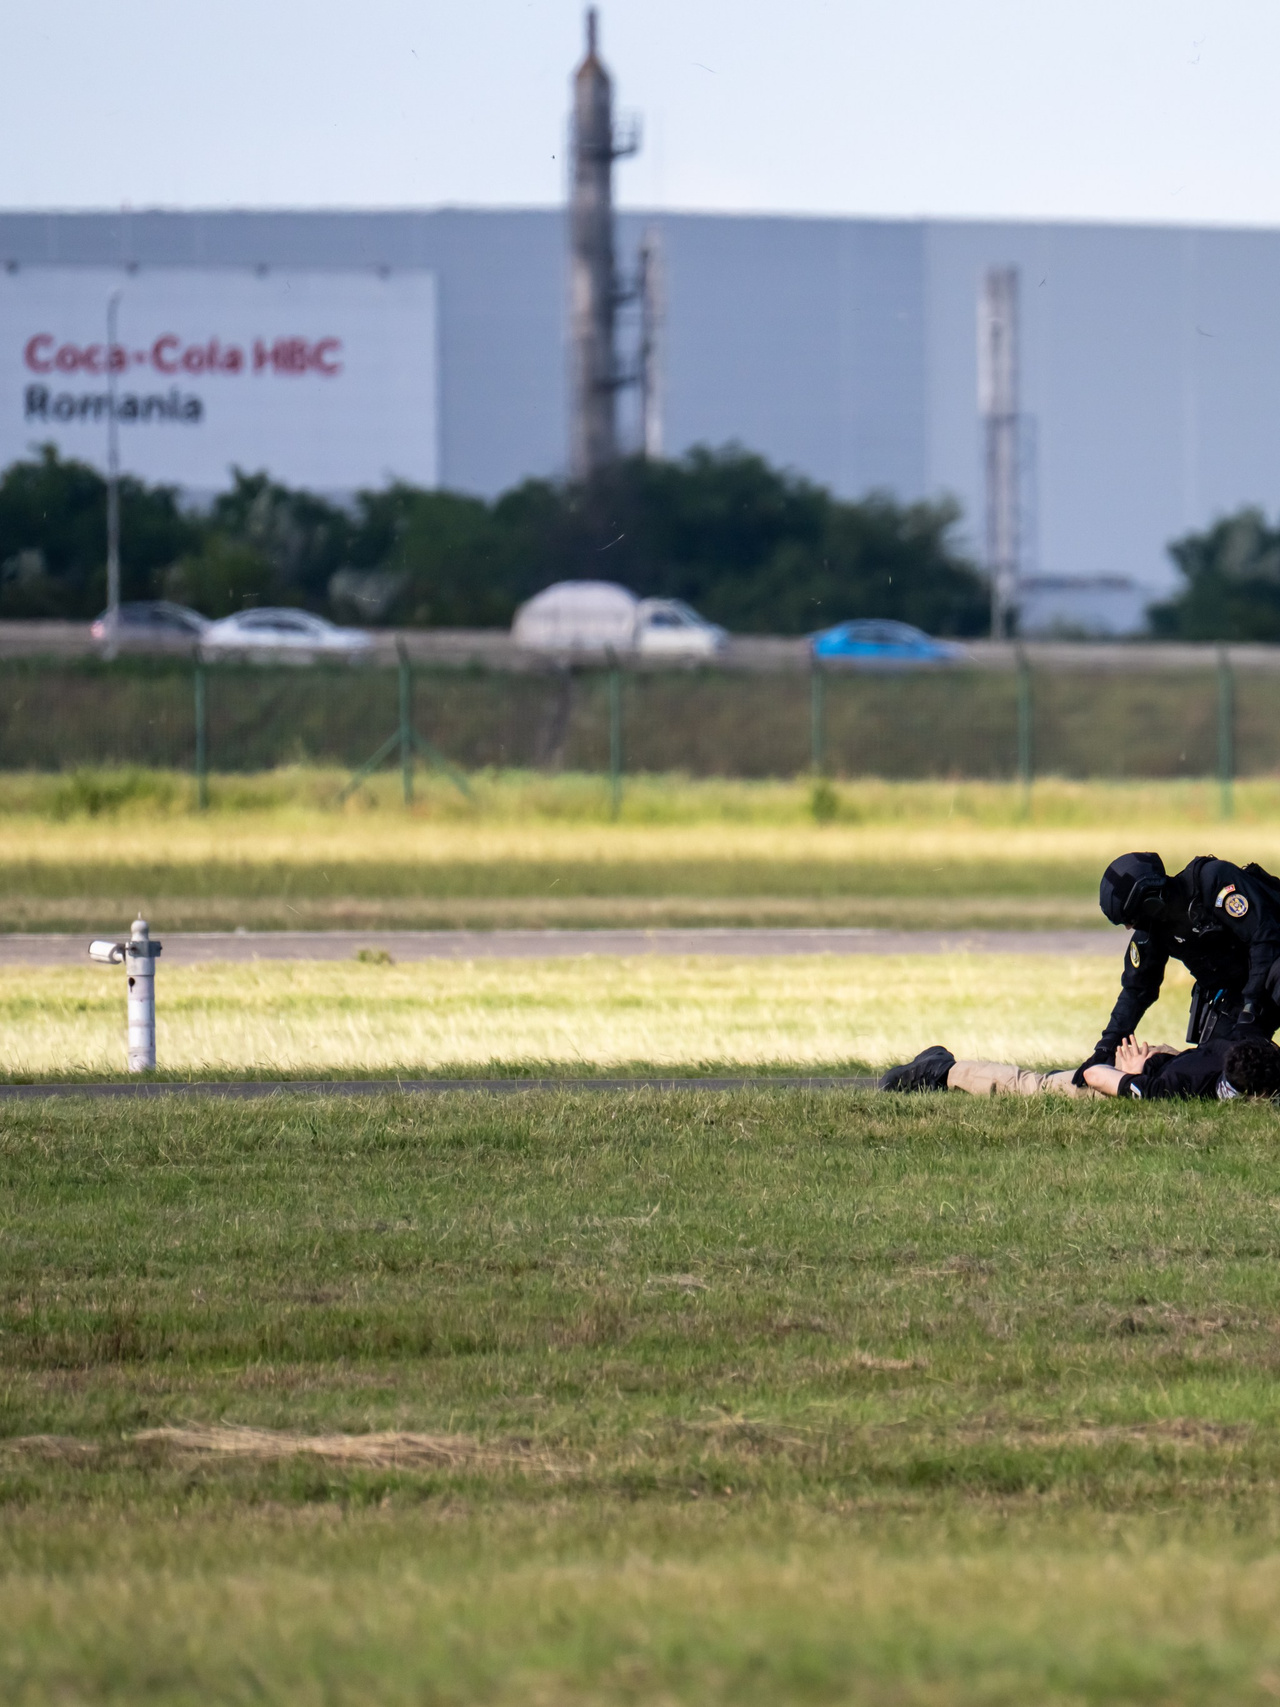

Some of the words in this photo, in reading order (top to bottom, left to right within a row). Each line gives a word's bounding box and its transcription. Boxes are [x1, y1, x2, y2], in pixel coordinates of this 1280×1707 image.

[24, 332, 243, 375] Coca-Cola
[252, 336, 343, 376] HBC
[24, 383, 204, 423] Romania
